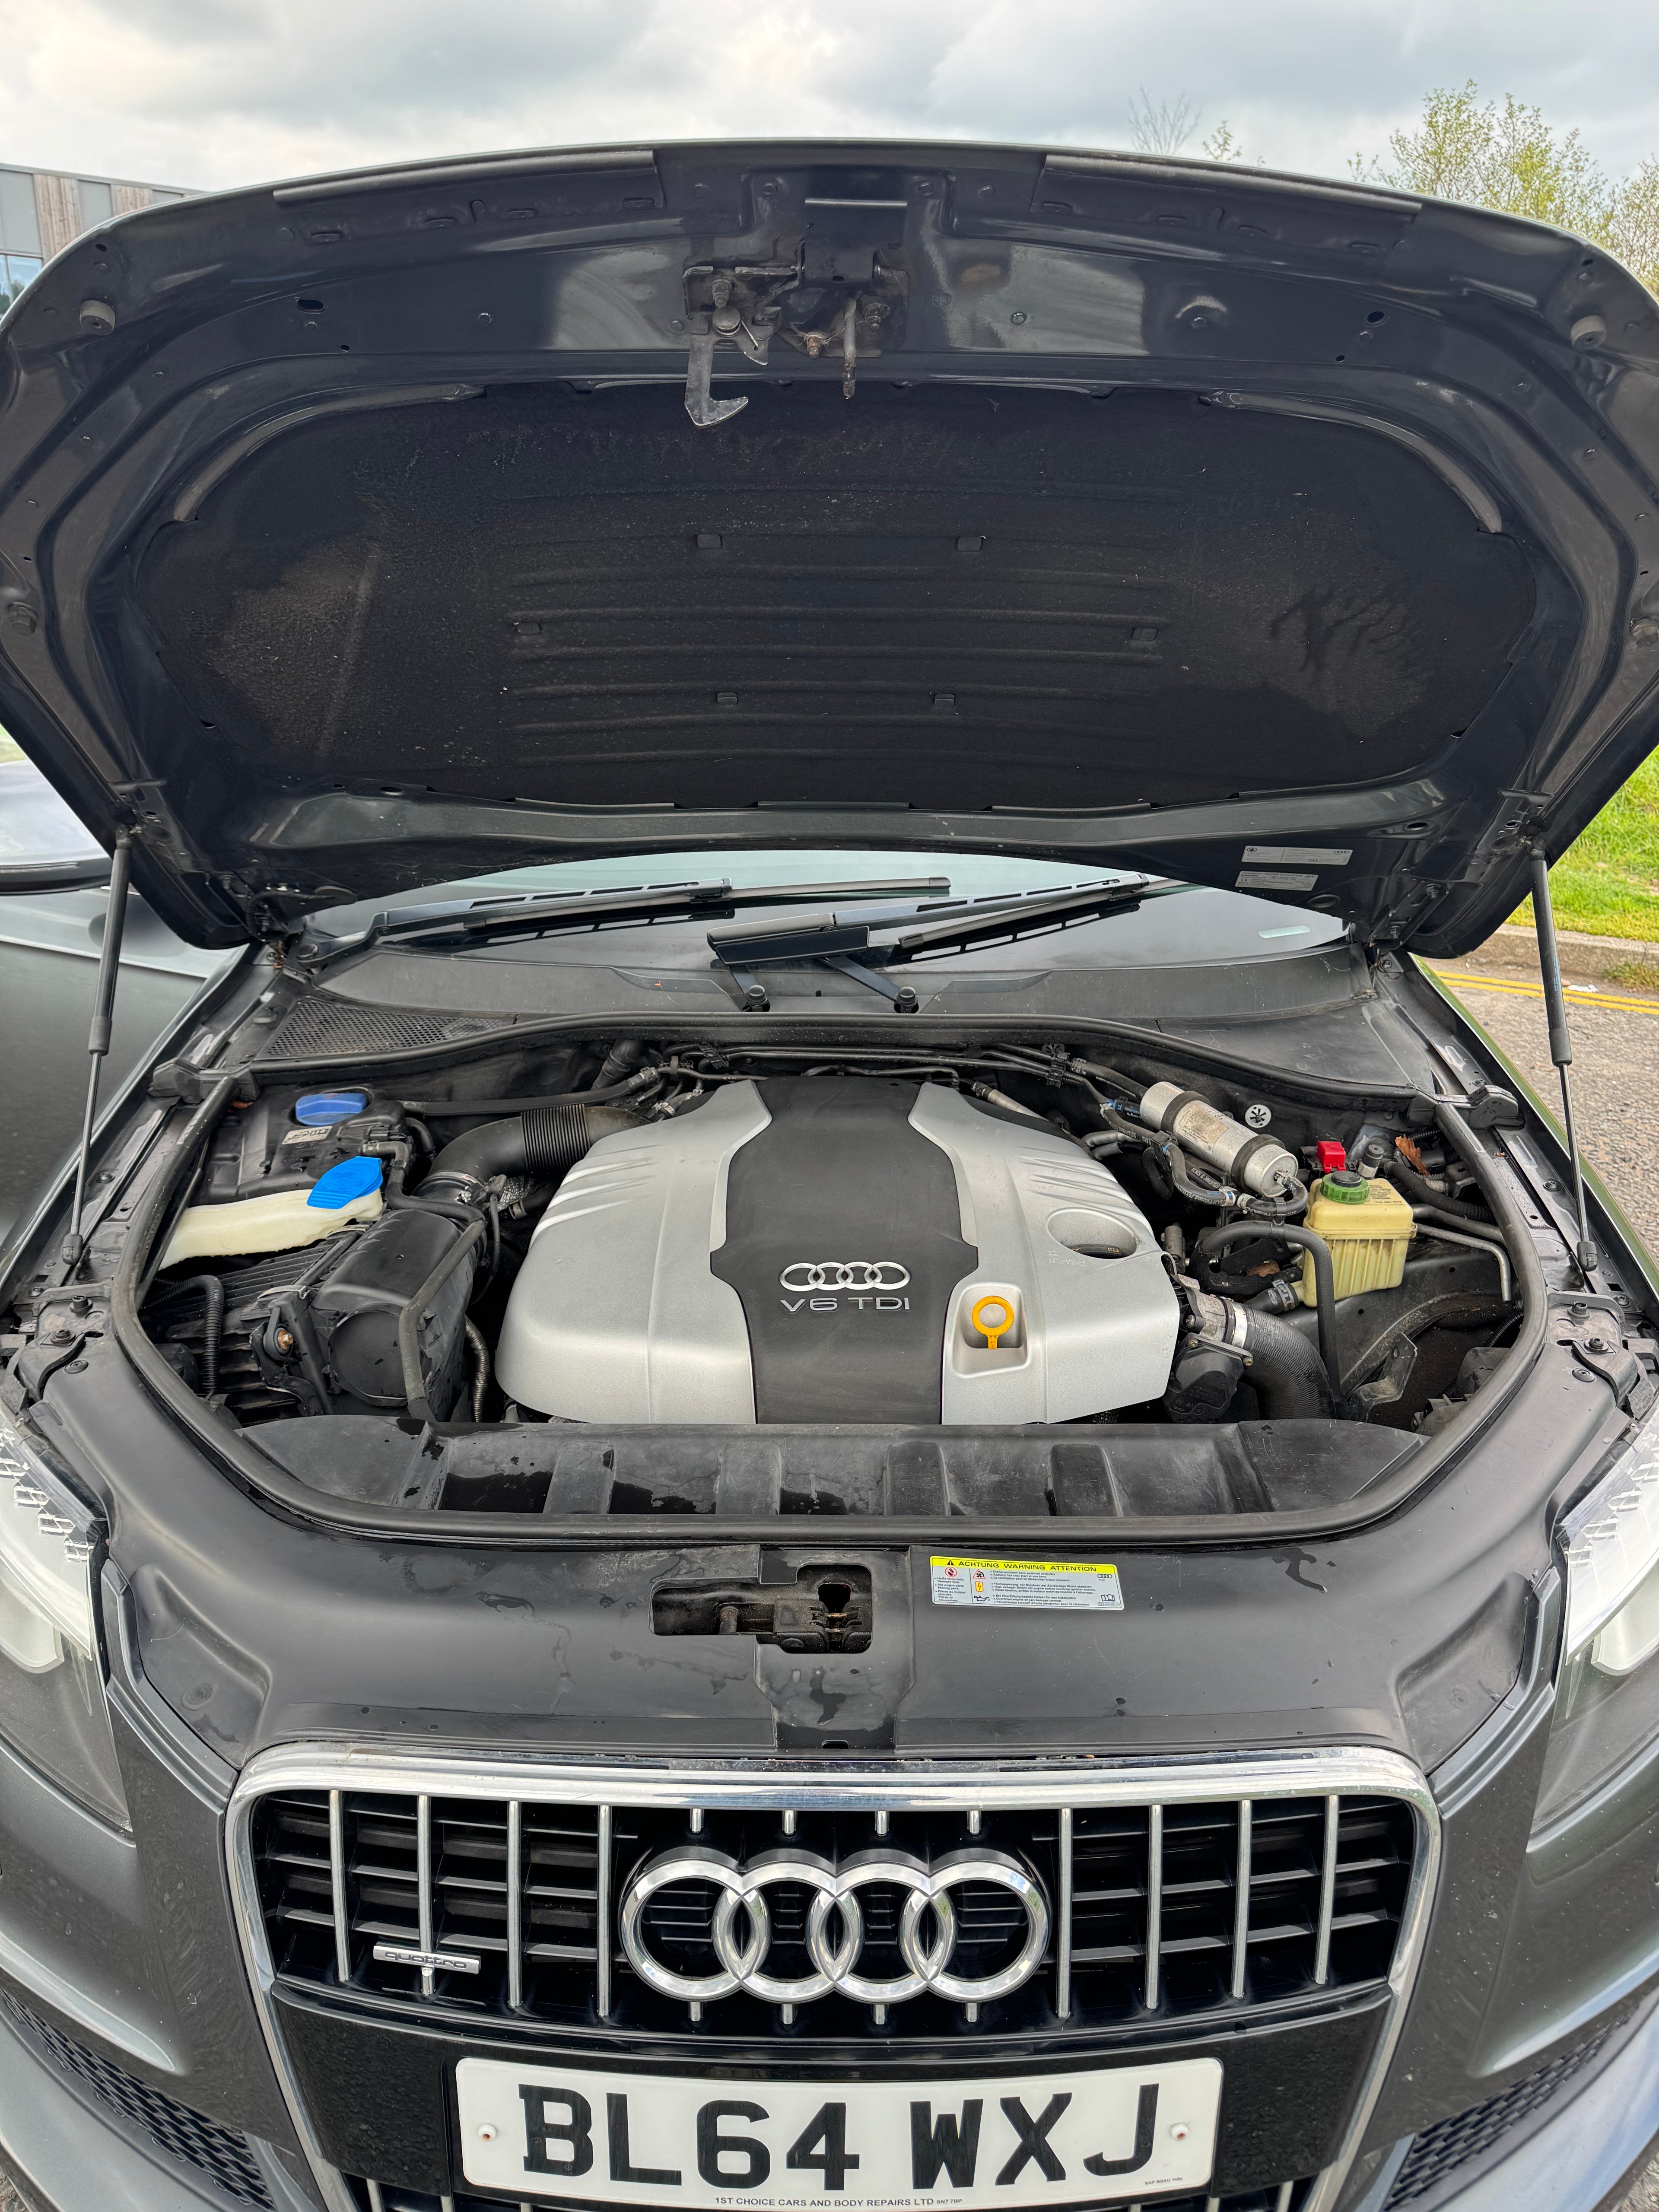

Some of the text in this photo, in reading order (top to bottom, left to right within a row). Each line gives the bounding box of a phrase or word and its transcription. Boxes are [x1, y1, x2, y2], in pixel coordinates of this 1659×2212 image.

[780, 1297, 910, 1313] V6 TDI
[385, 1951, 467, 1969] quattro
[519, 2083, 1160, 2190] BL64 WXJ
[736, 2197, 775, 2206] CHOICE
